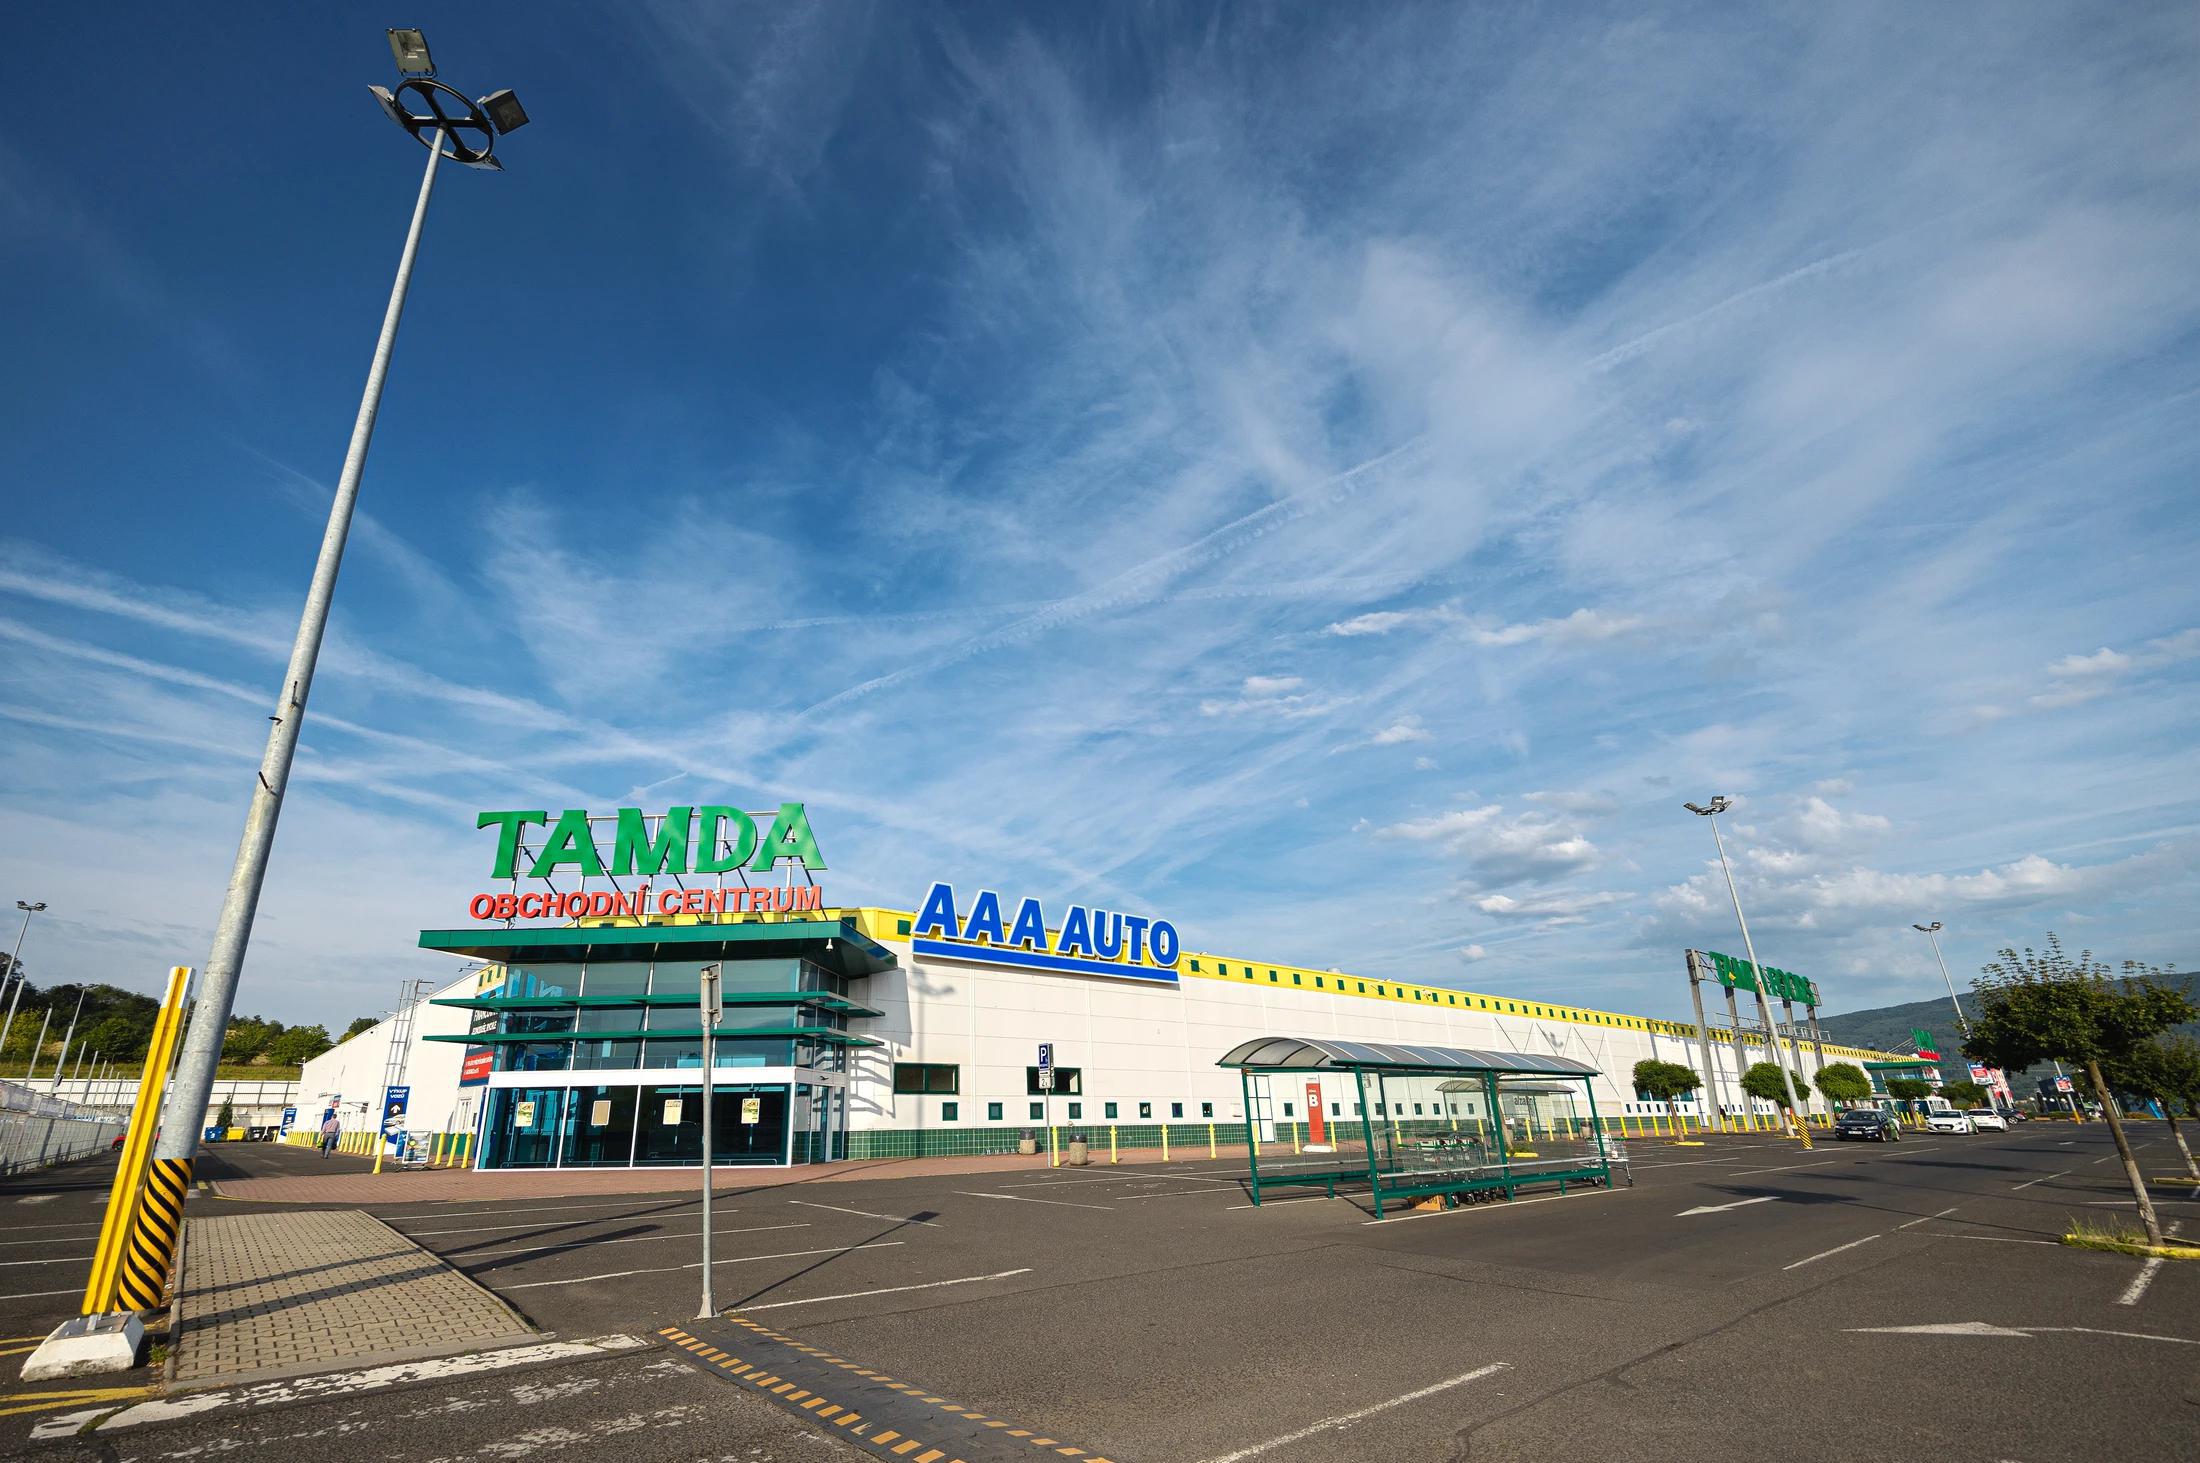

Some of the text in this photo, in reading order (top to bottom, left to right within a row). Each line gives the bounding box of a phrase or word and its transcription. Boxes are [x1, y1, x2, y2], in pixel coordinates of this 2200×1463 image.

[476, 802, 828, 878] TAMDA
[468, 883, 823, 920] OBCHODNÍ CENTRUM
[1056, 905, 1181, 968] AUTO
[1041, 1047, 1047, 1062] P
[1308, 1094, 1319, 1107] B
